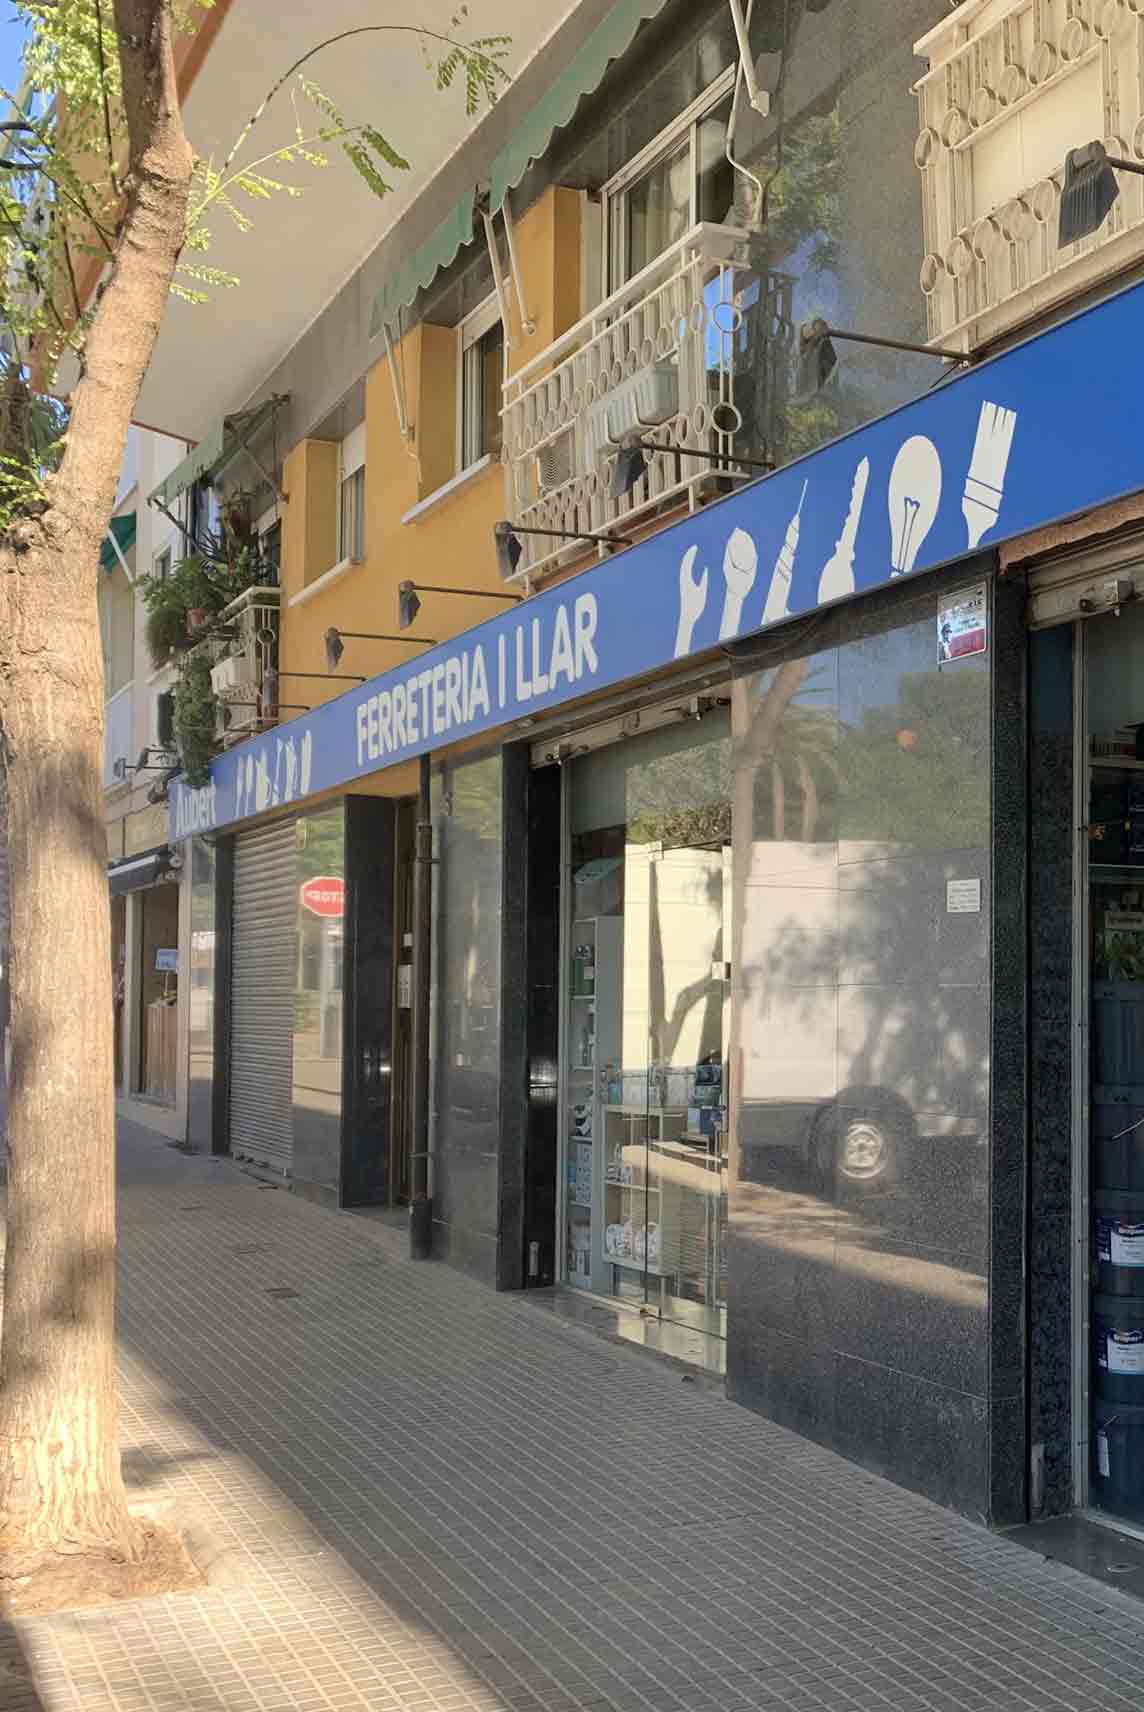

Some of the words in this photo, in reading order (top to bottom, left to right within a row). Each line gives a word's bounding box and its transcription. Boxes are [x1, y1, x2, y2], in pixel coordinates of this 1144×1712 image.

[356, 643, 491, 767] FERRETERIA
[497, 633, 506, 708] I
[516, 592, 599, 702] LLAR
